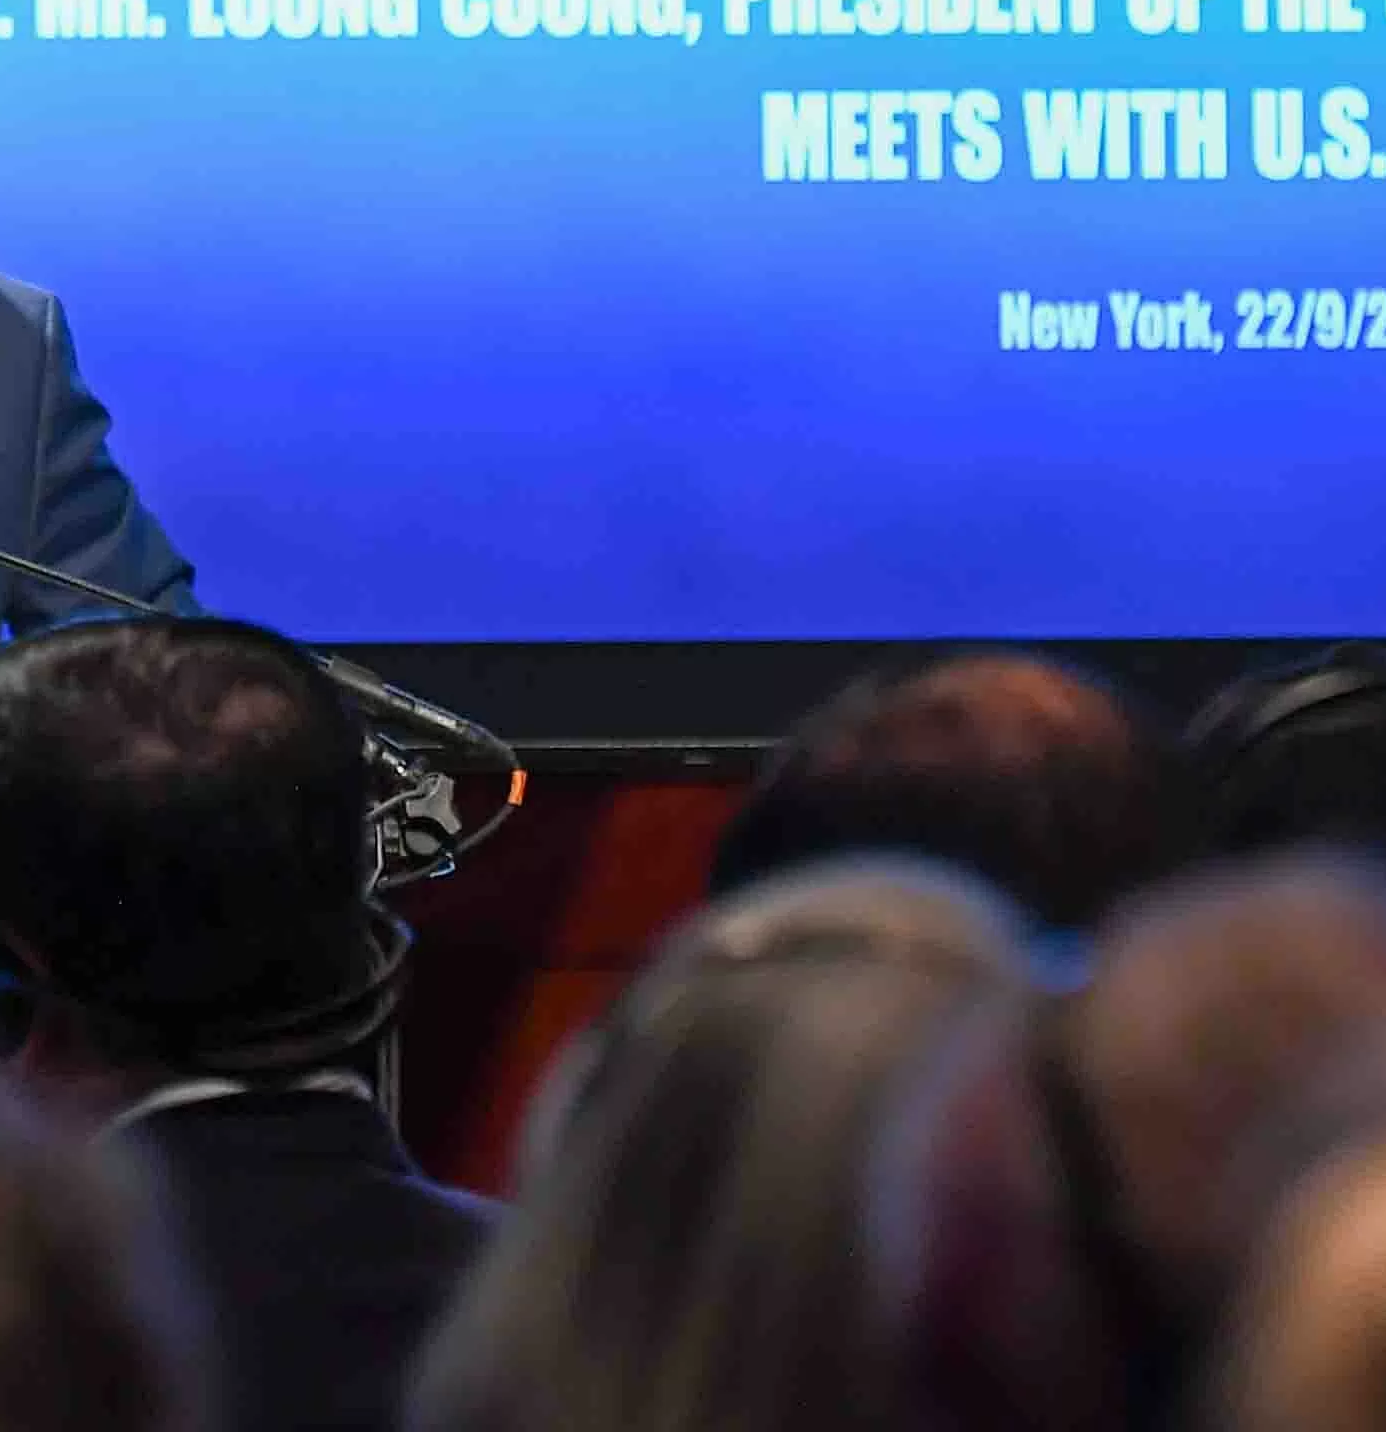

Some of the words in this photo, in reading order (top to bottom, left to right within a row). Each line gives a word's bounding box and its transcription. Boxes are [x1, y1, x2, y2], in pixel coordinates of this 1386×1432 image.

[763, 90, 1002, 181] MEETS
[1024, 90, 1228, 179] WITH
[998, 291, 1099, 351] New
[1110, 290, 1224, 354] York,
